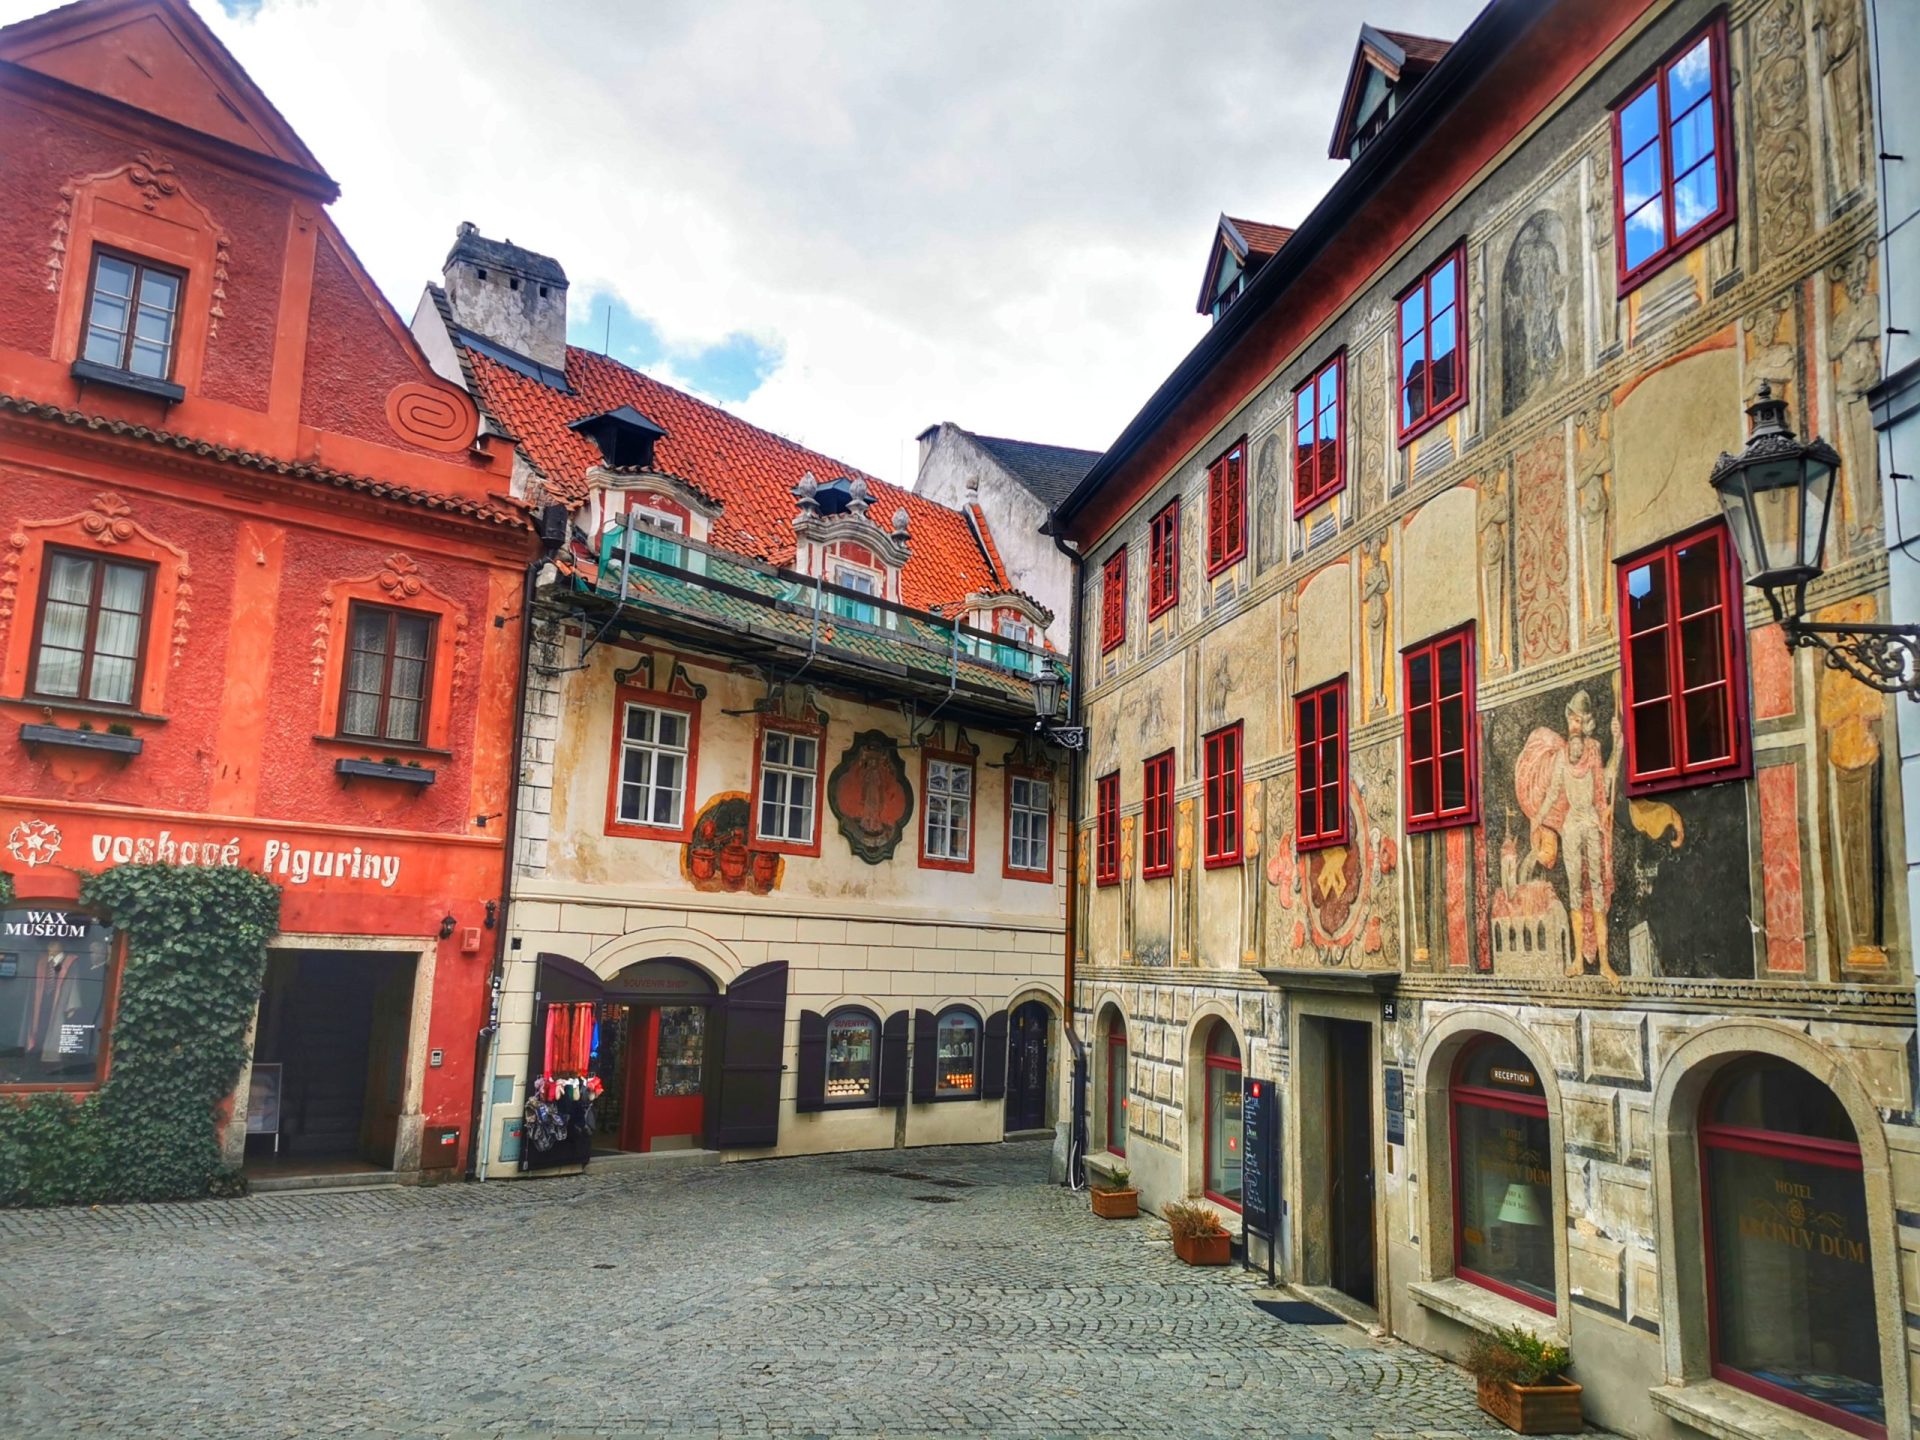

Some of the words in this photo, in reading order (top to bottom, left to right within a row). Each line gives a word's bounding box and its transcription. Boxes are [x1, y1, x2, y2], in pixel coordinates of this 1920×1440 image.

[27, 911, 67, 925] WAX
[4, 923, 86, 938] MUSEUM
[1494, 1070, 1530, 1084] RECEPTION
[1775, 1179, 1815, 1200] HOTEL
